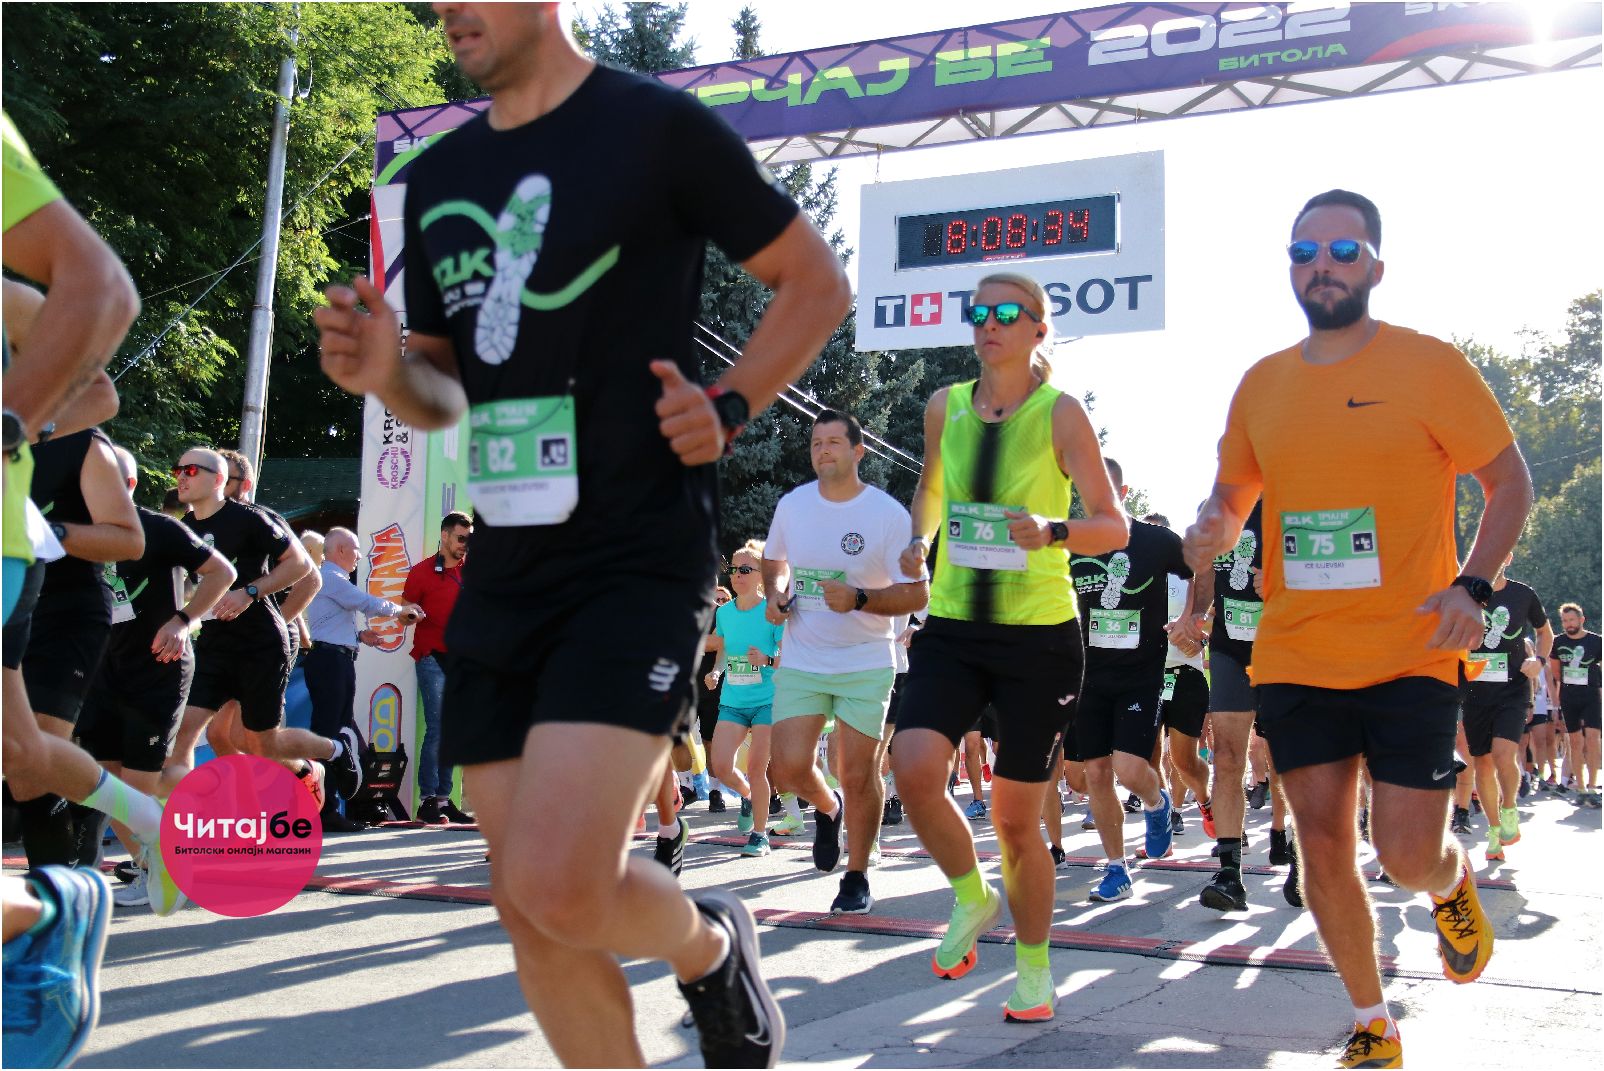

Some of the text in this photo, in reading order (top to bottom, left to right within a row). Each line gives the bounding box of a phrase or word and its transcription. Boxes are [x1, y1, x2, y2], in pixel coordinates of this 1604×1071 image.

[686, 2, 1351, 107] РЧАЈ БЕ 2022
[1218, 43, 1347, 71] БИТОЛА
[946, 208, 1090, 254] 8:08:34
[948, 274, 1153, 324] TSOT
[391, 446, 399, 490] KROSCHU
[487, 437, 517, 473] 82
[973, 522, 995, 541] 76
[1308, 533, 1336, 556] 75
[1105, 620, 1121, 632] 36
[1239, 612, 1252, 624] 81
[736, 663, 746, 673] 77
